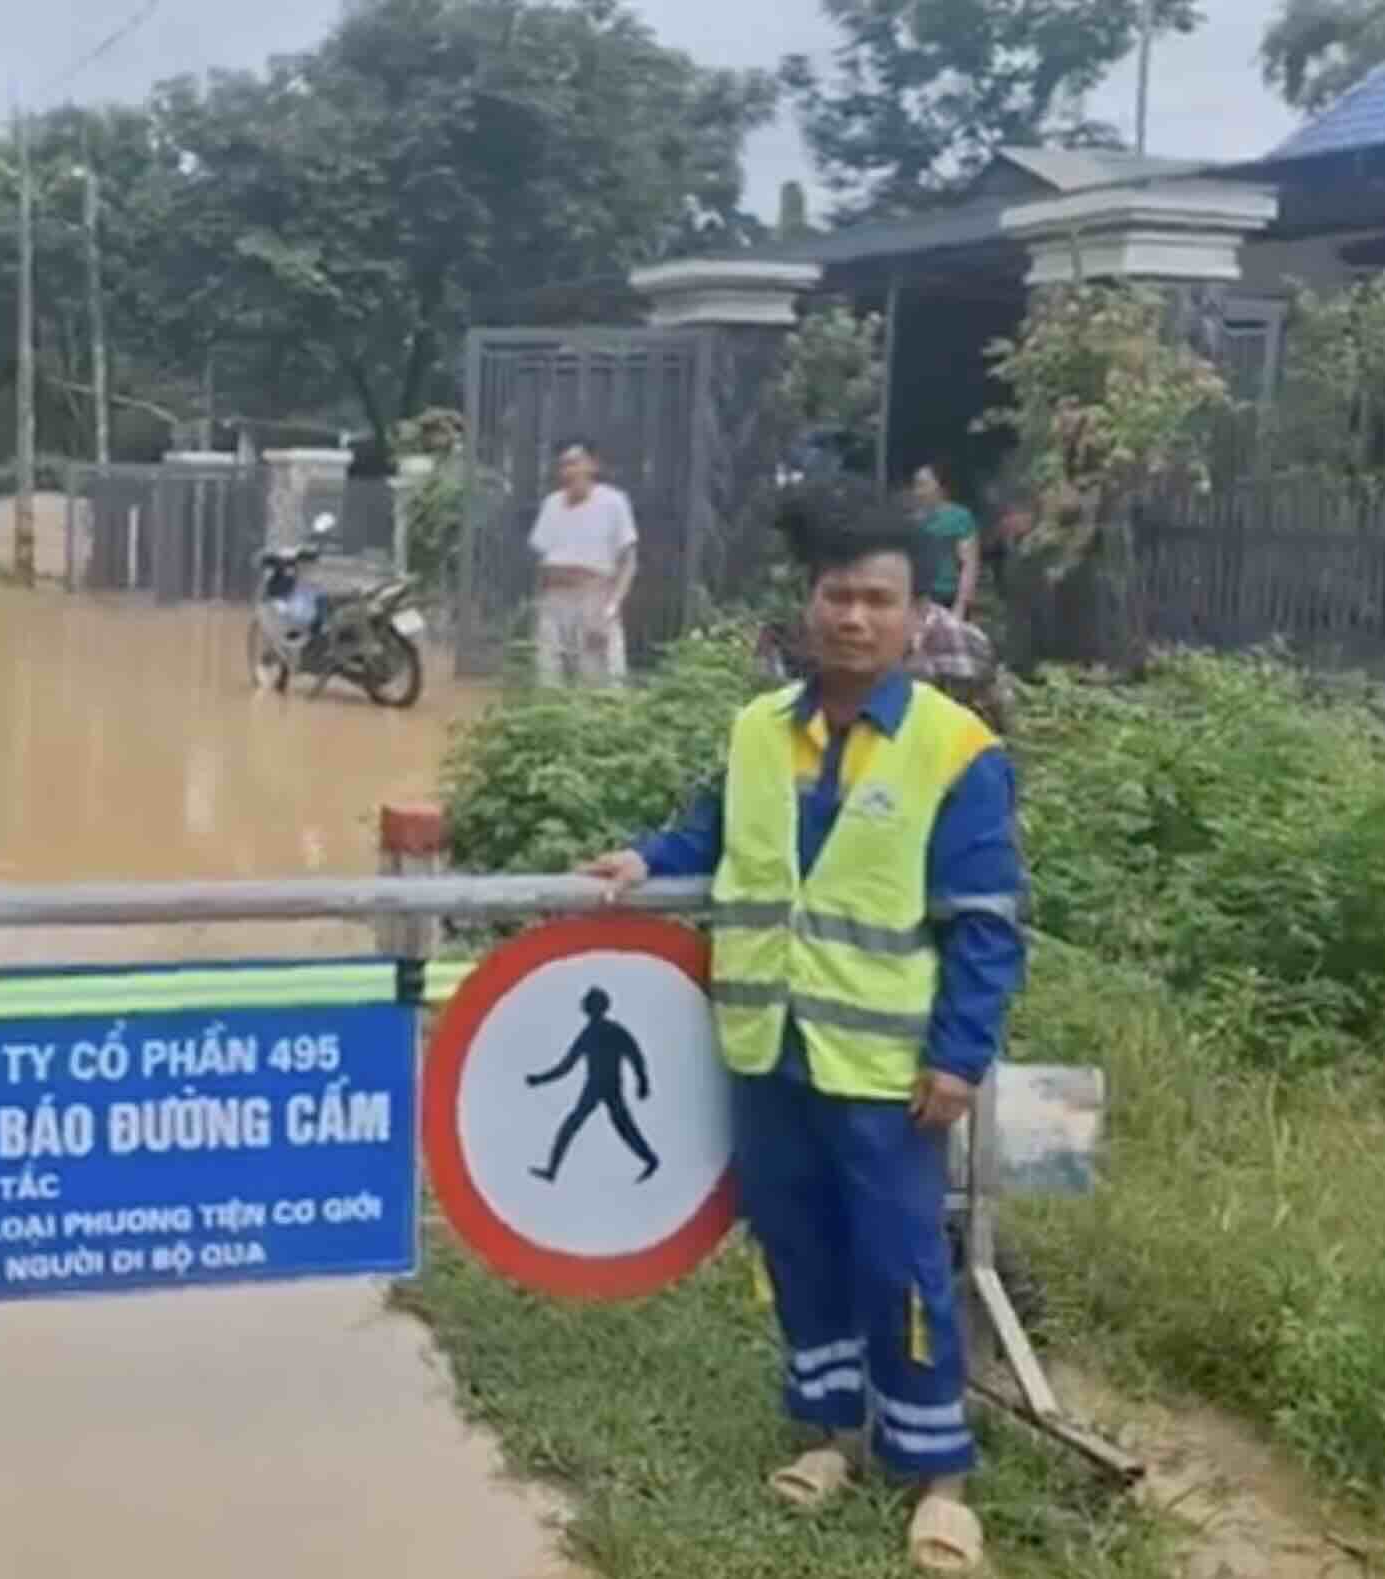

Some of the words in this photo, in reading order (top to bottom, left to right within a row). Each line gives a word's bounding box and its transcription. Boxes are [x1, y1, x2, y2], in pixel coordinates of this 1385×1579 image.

[2, 1044, 56, 1084] TY
[70, 1019, 130, 1082] CỔ
[142, 1020, 257, 1077] PHẦN
[268, 1033, 340, 1072] 495
[108, 1085, 271, 1154] ĐƯỜNG
[287, 1075, 391, 1145] CẤM
[199, 1196, 265, 1232] TIỆN
[152, 1240, 195, 1277] BỘ
[199, 1241, 267, 1268] QUA
